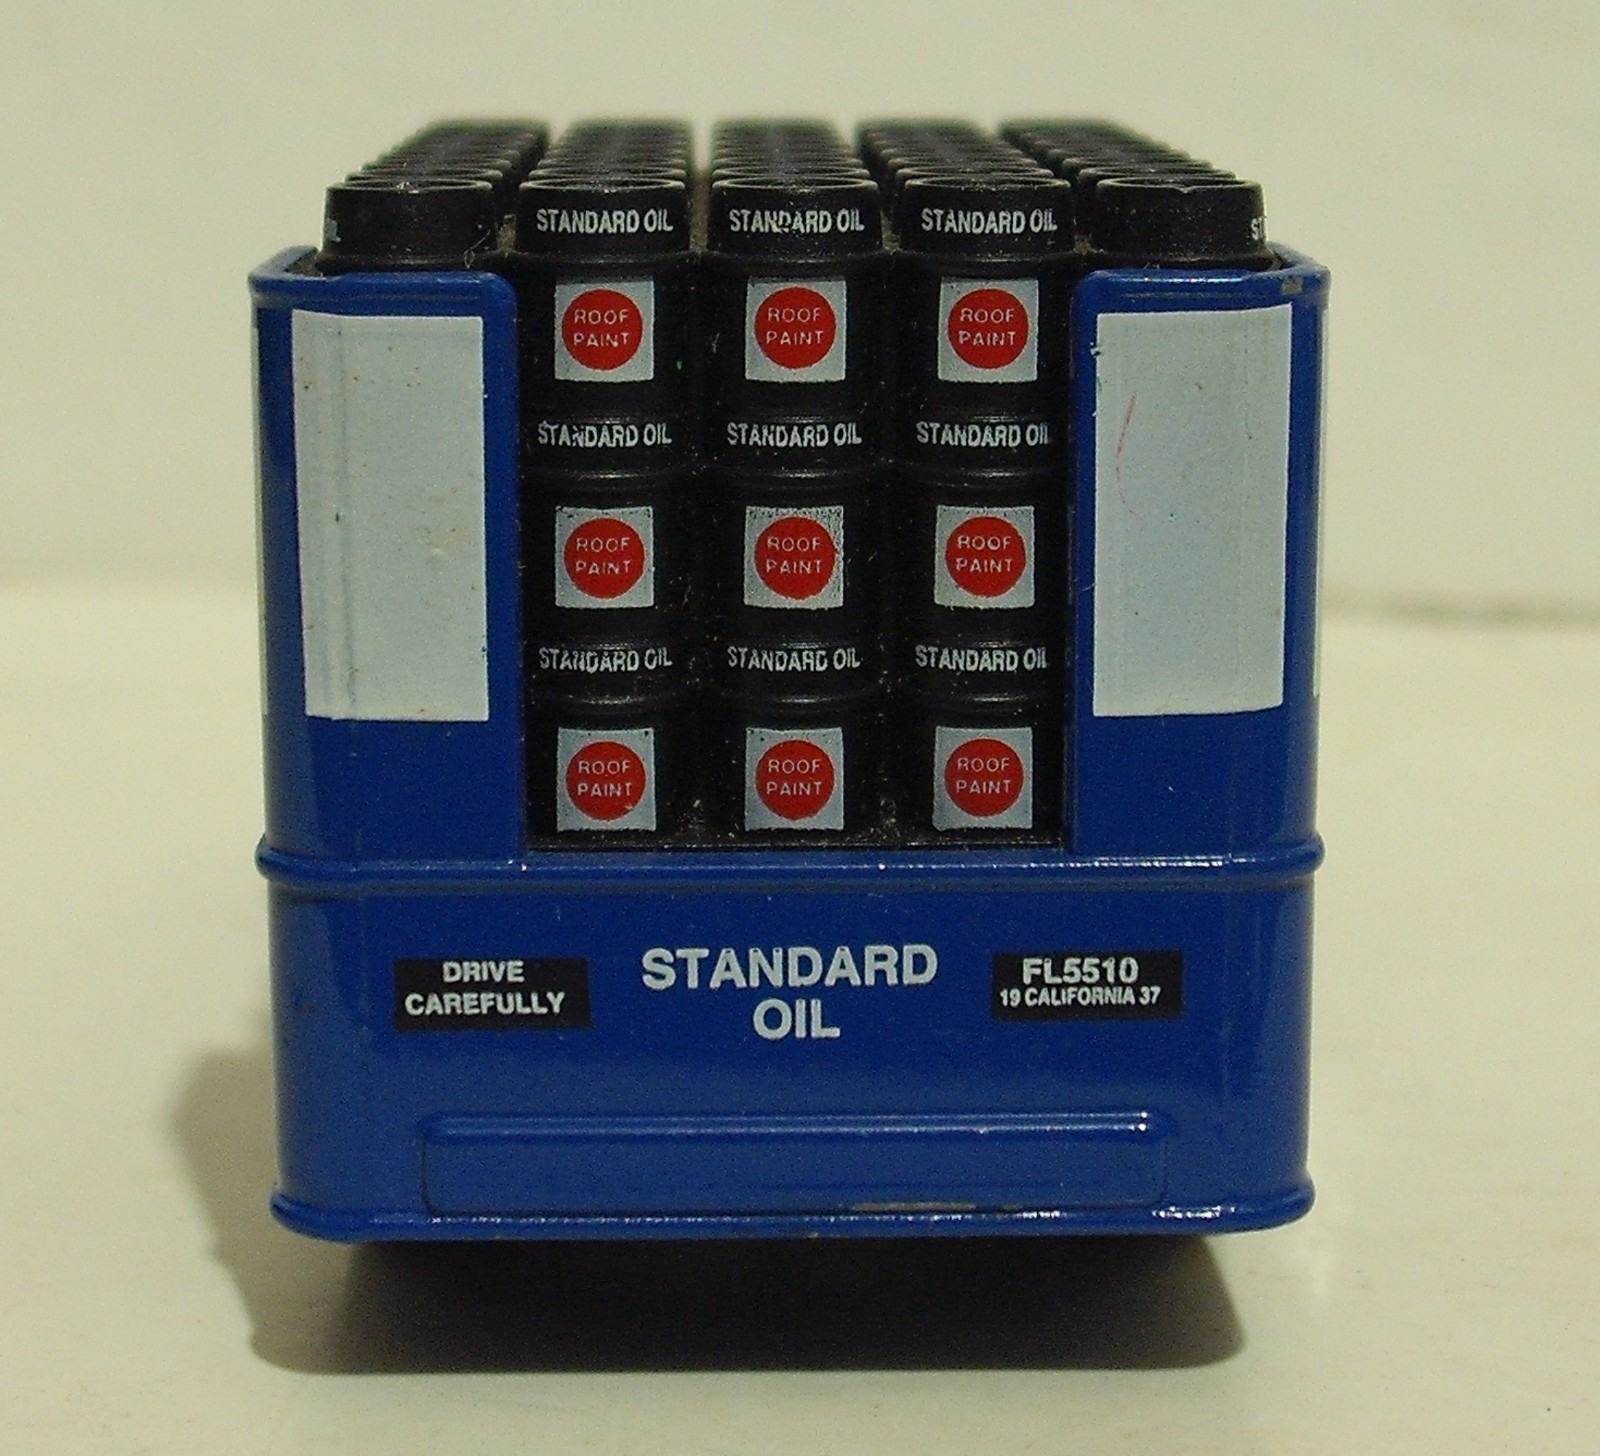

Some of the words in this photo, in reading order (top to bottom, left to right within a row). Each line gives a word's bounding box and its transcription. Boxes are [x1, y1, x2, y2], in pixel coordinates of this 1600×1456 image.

[537, 209, 639, 233] STANDARD
[644, 209, 673, 232] OIL
[730, 210, 832, 233] STANDARD
[837, 209, 864, 232] OIL
[922, 209, 1025, 233] STANDARD
[1030, 210, 1057, 232] OIL
[574, 308, 629, 325] ROOF
[767, 307, 822, 323] ROOF
[959, 307, 1016, 324] ROOF
[573, 332, 630, 348] PAINT
[766, 330, 825, 345] PAINT
[958, 330, 1017, 346] PAINT
[539, 423, 638, 447] STANDARD
[644, 424, 672, 445] OIL
[728, 423, 828, 447] STANDARD
[834, 423, 862, 446] OIL
[917, 423, 1020, 446] STANDARD
[576, 536, 631, 553] ROOF
[767, 536, 821, 552] ROOF
[957, 534, 1012, 551] ROOF
[575, 560, 632, 575] PAINT
[766, 559, 822, 574] PAINT
[955, 557, 1013, 573] PAINT
[540, 647, 639, 673] STANDARD
[645, 648, 672, 669] OIL
[728, 647, 828, 671] STANDARD
[834, 648, 860, 669] OIL
[916, 647, 1018, 672] STANDARD
[578, 759, 632, 775] ROOF
[768, 758, 821, 774] ROOF
[957, 757, 1011, 773] ROOF
[577, 782, 633, 797] PAINT
[766, 781, 823, 796] PAINT
[955, 779, 1012, 794] PAINT
[443, 961, 524, 982] DRIVE
[643, 944, 937, 989] STANDARD
[1023, 957, 1138, 984] FL5510
[405, 992, 564, 1015] CAREFULLY
[1001, 989, 1020, 1006] 19
[1025, 987, 1135, 1006] CALIFORNIA
[1140, 986, 1160, 1004] 37
[754, 999, 840, 1039] OIL
